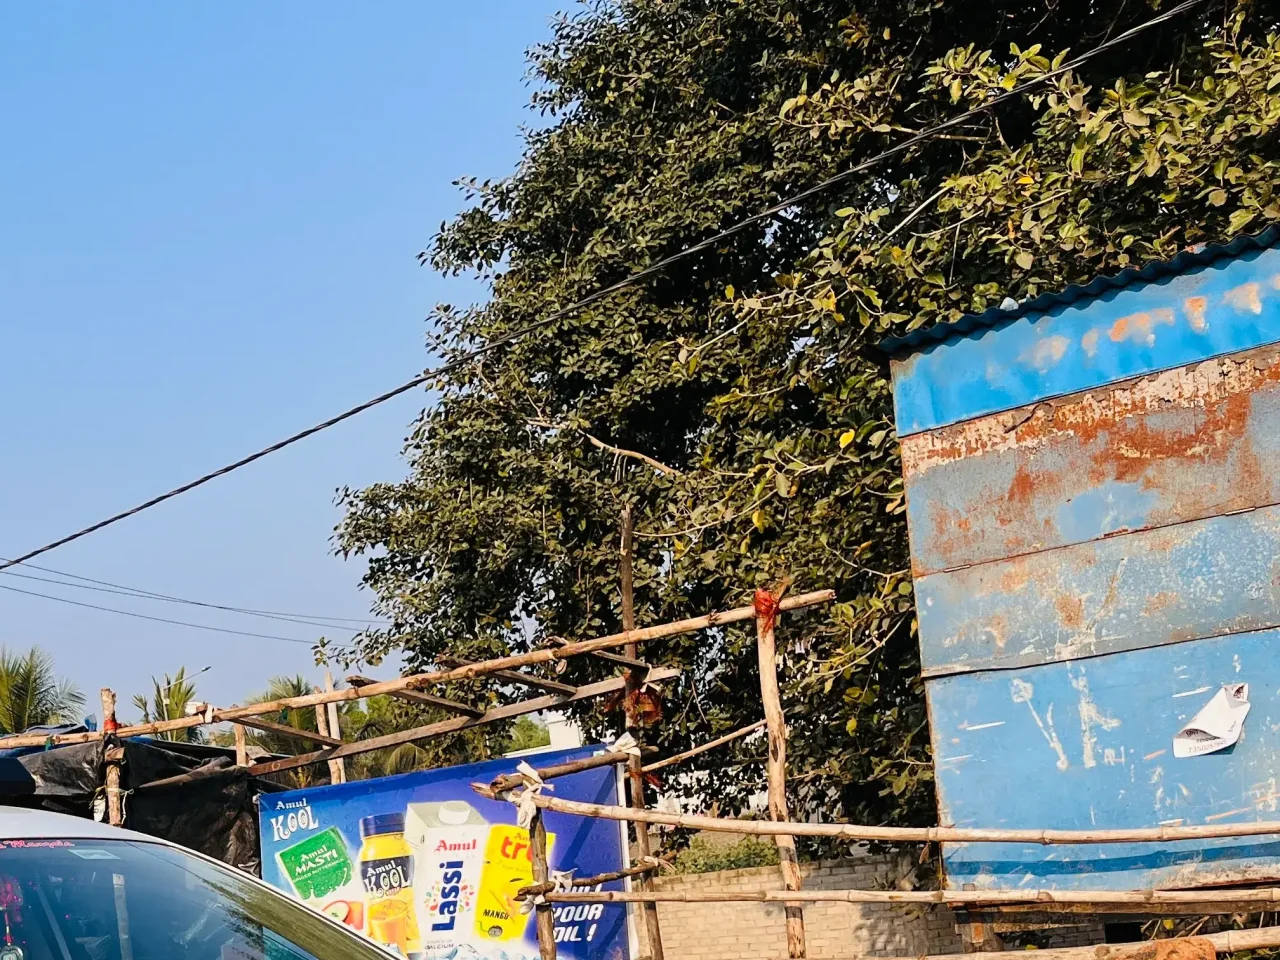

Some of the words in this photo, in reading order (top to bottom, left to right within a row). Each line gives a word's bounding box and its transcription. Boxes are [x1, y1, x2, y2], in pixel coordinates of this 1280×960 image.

[276, 797, 308, 811] Amul
[270, 805, 319, 842] KOOL
[300, 844, 328, 863] Amul
[434, 838, 477, 853] Amul
[294, 848, 339, 877] MASTI
[367, 860, 397, 878] Amul
[363, 865, 412, 900] KOOL
[431, 860, 464, 932] Lassi
[483, 908, 510, 921] MANGO
